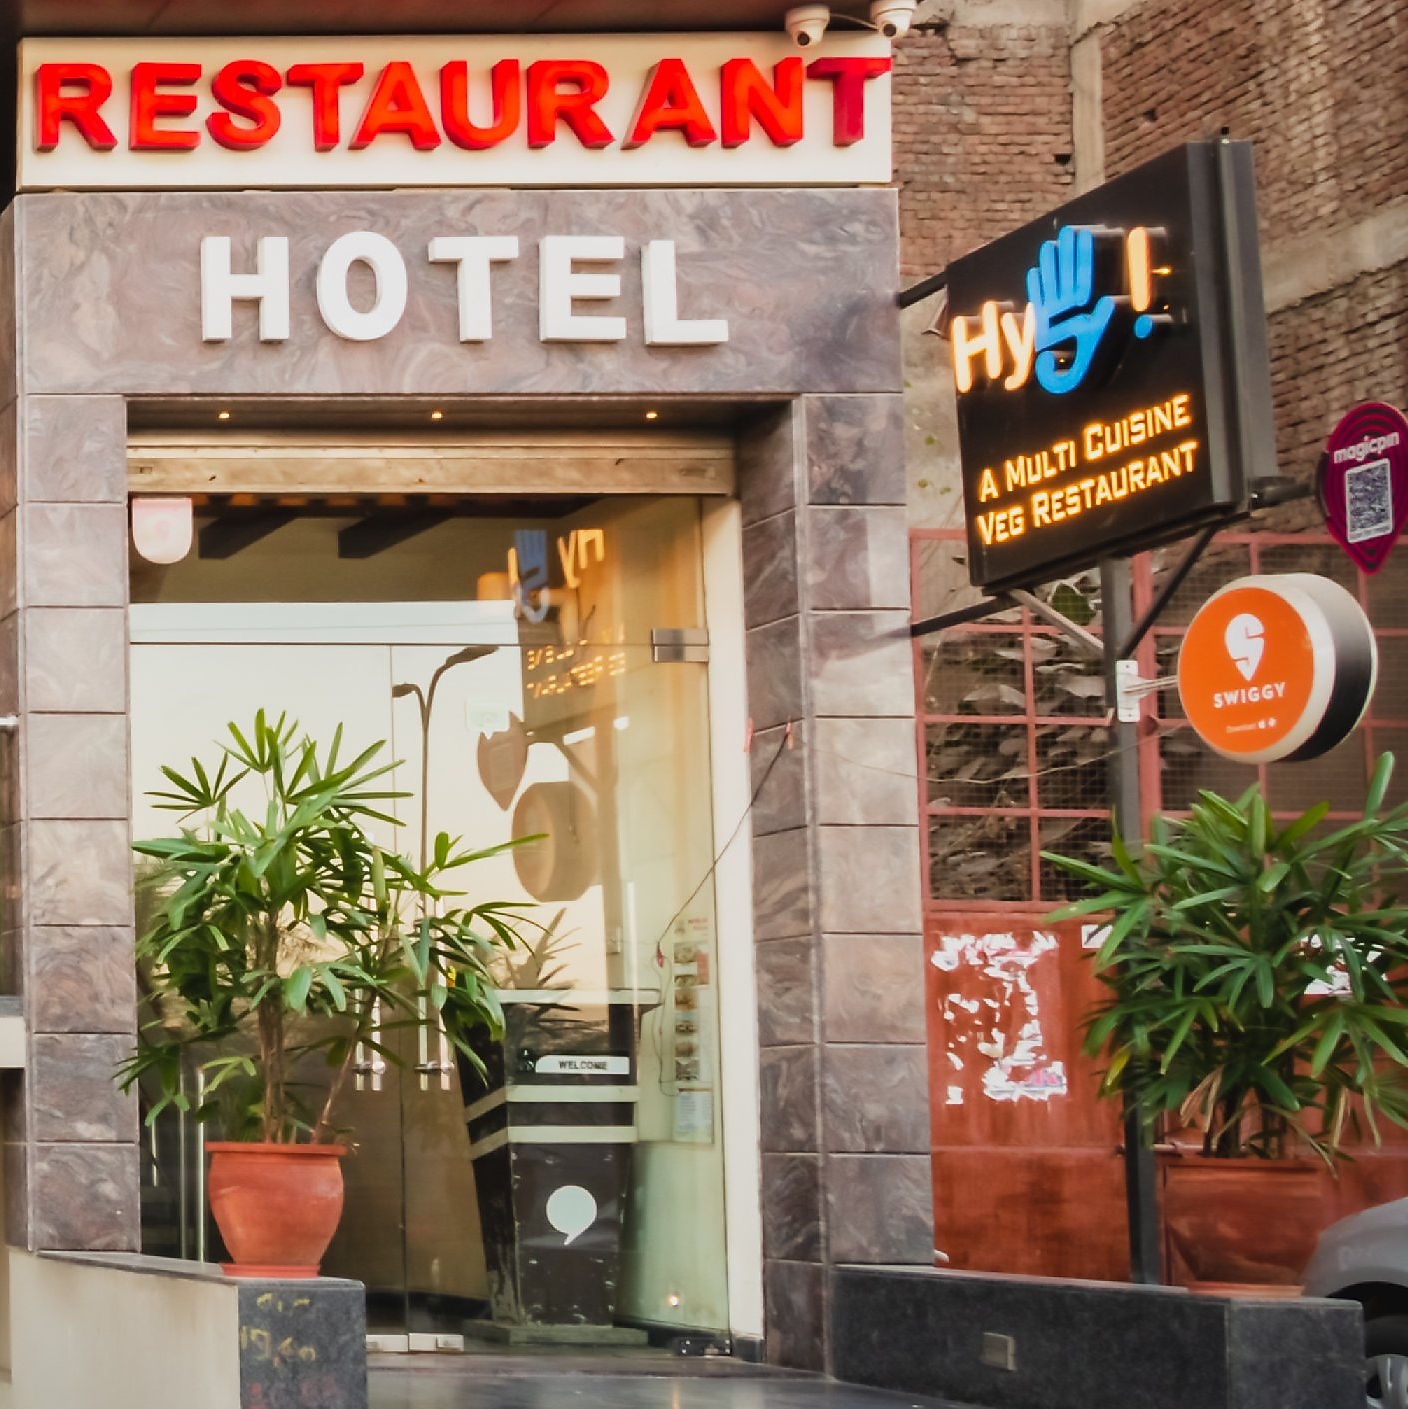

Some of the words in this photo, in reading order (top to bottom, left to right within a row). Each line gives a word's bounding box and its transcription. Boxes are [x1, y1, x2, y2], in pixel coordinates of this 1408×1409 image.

[33, 56, 893, 153] RESTAURANT
[199, 230, 730, 348] HOTEL
[976, 506, 1026, 546] VEG
[1031, 441, 1199, 528] RESTAURANT
[978, 468, 998, 503] A
[1005, 438, 1077, 492] MULTI
[1083, 393, 1192, 461] CUISINE
[1333, 432, 1400, 463] magicpin
[1213, 682, 1286, 708] SWIGGY
[558, 1060, 608, 1071] WELCOME
